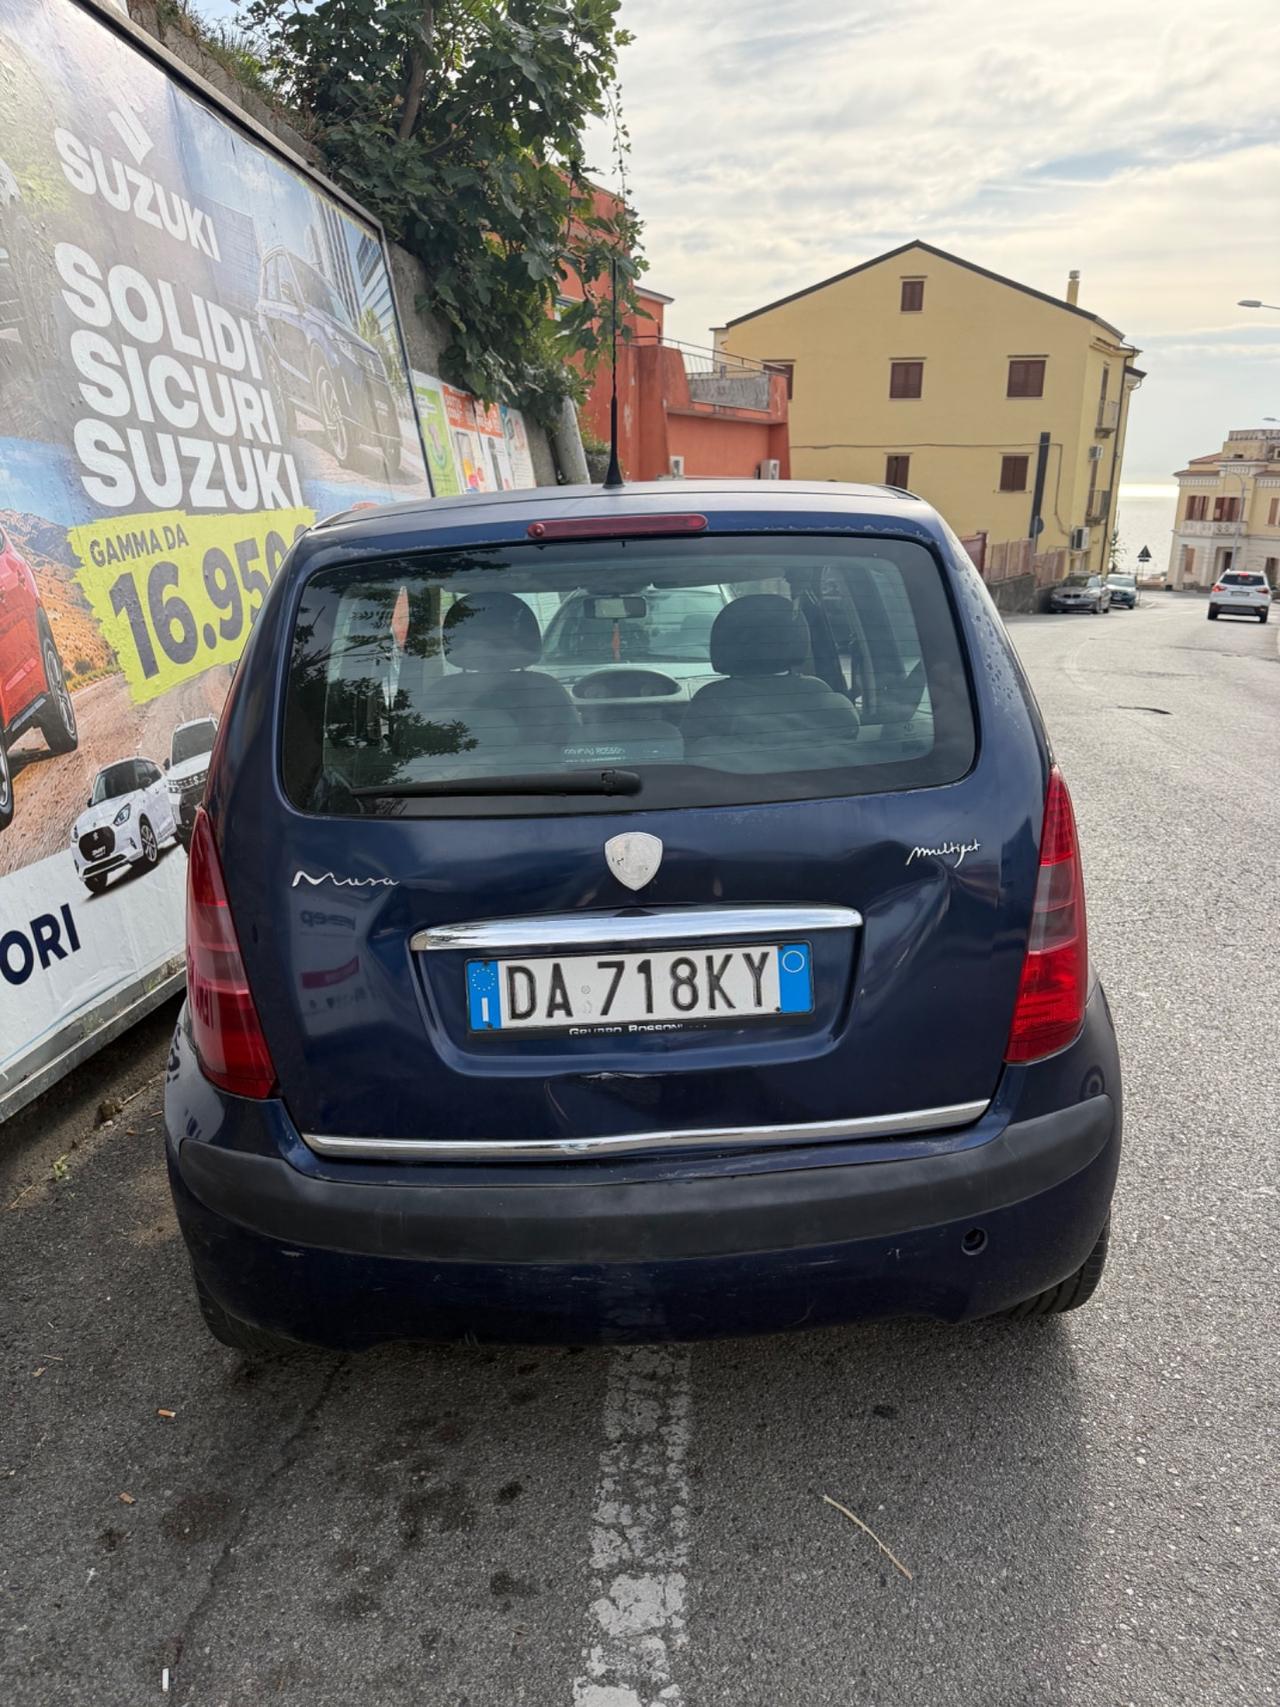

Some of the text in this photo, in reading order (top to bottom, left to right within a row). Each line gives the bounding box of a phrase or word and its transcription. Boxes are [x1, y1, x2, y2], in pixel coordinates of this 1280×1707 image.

[54, 128, 221, 262] SUZUKI
[55, 242, 262, 380] SOLIDI
[70, 329, 282, 446] SICURI
[73, 418, 304, 510] SUZUKI
[89, 523, 189, 567] GAMMA DA
[292, 870, 400, 887] Musa
[0, 903, 81, 985] ORI
